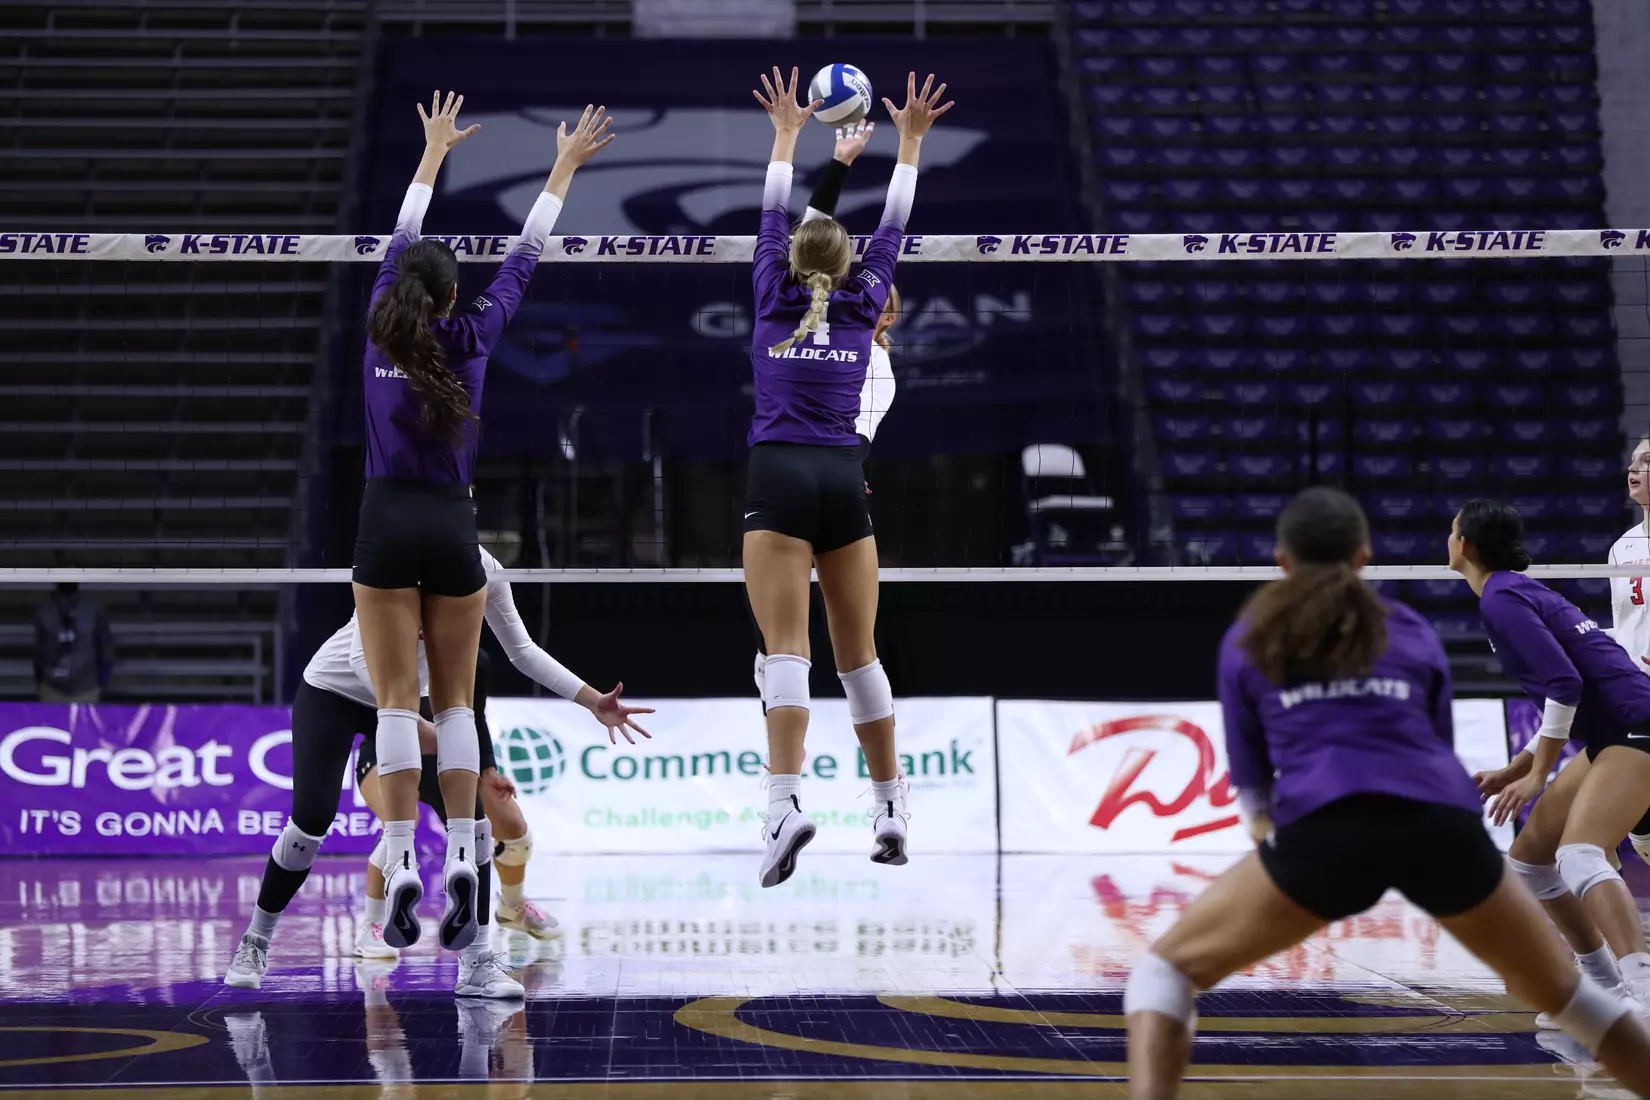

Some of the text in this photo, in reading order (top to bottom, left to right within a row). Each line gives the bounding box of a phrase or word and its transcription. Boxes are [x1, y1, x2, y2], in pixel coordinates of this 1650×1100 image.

[180, 235, 300, 255] K-STATE
[597, 236, 716, 256] K-STATE
[1012, 235, 1129, 255] K-STATE
[1218, 233, 1336, 253] K-STATE
[1426, 231, 1545, 252] K-STATE
[768, 347, 858, 362] WILDCATS
[1279, 678, 1411, 709] WILDCATS
[0, 726, 234, 790] Great
[581, 745, 837, 780] Commee
[20, 809, 82, 835] IT'S
[96, 808, 225, 836] GONNA
[238, 810, 284, 836] BE
[583, 808, 730, 831] Challenge
